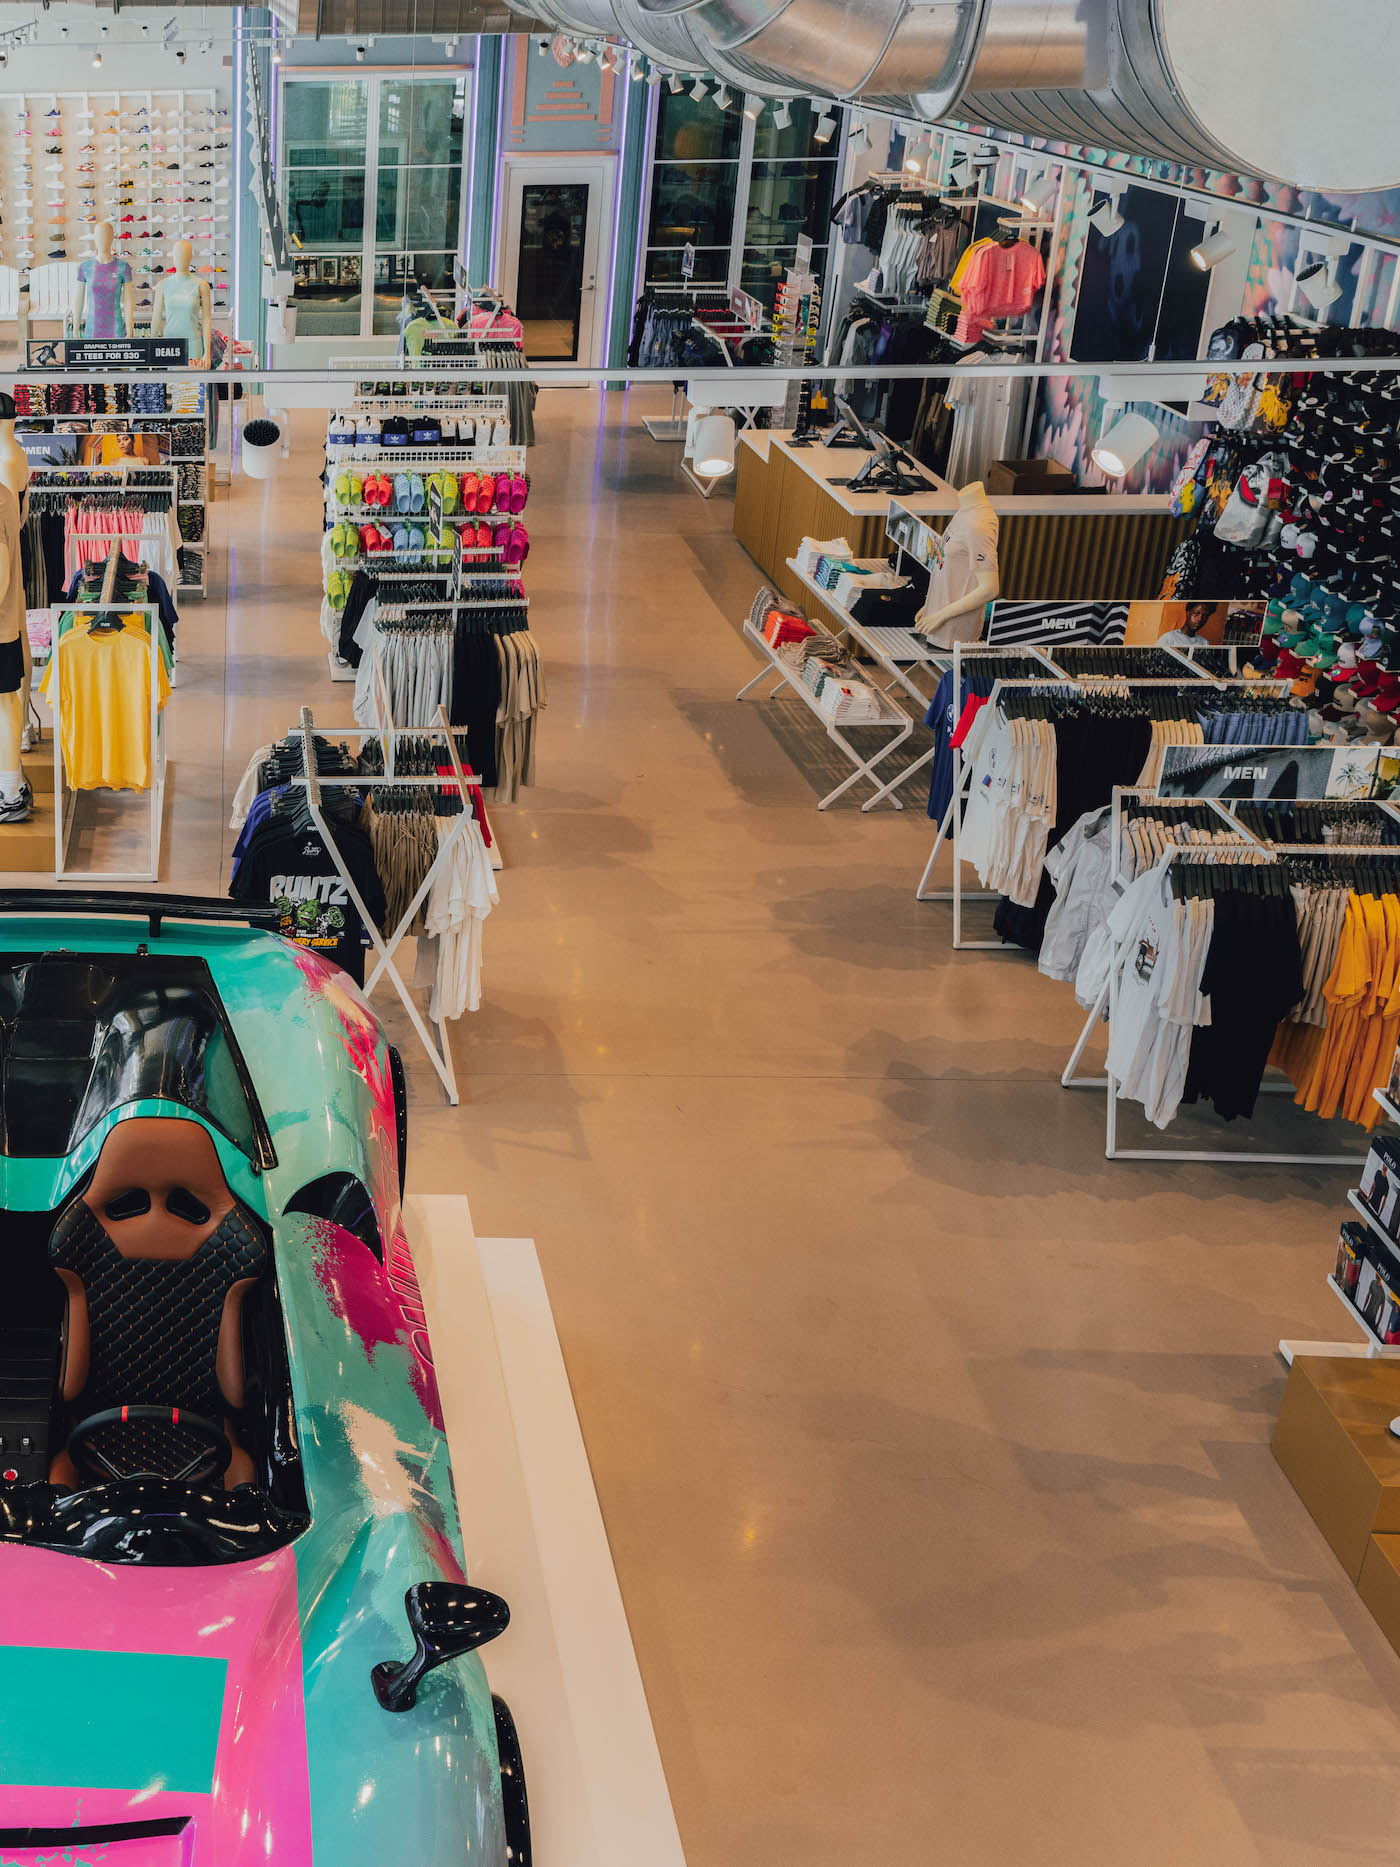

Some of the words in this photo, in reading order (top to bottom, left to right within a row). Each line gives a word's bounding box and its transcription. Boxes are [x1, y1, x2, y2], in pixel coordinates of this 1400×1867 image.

[105, 352, 122, 360] FOR
[123, 352, 140, 360] $30
[155, 347, 181, 357] DEALS
[1041, 618, 1077, 630] MEN
[1223, 766, 1268, 780] MEN
[270, 875, 348, 905] RUNTZ
[311, 937, 338, 947] SERVICE
[1383, 1151, 1397, 1170] POLO
[1342, 1228, 1354, 1246] POLO
[1376, 1262, 1391, 1281] POLO
